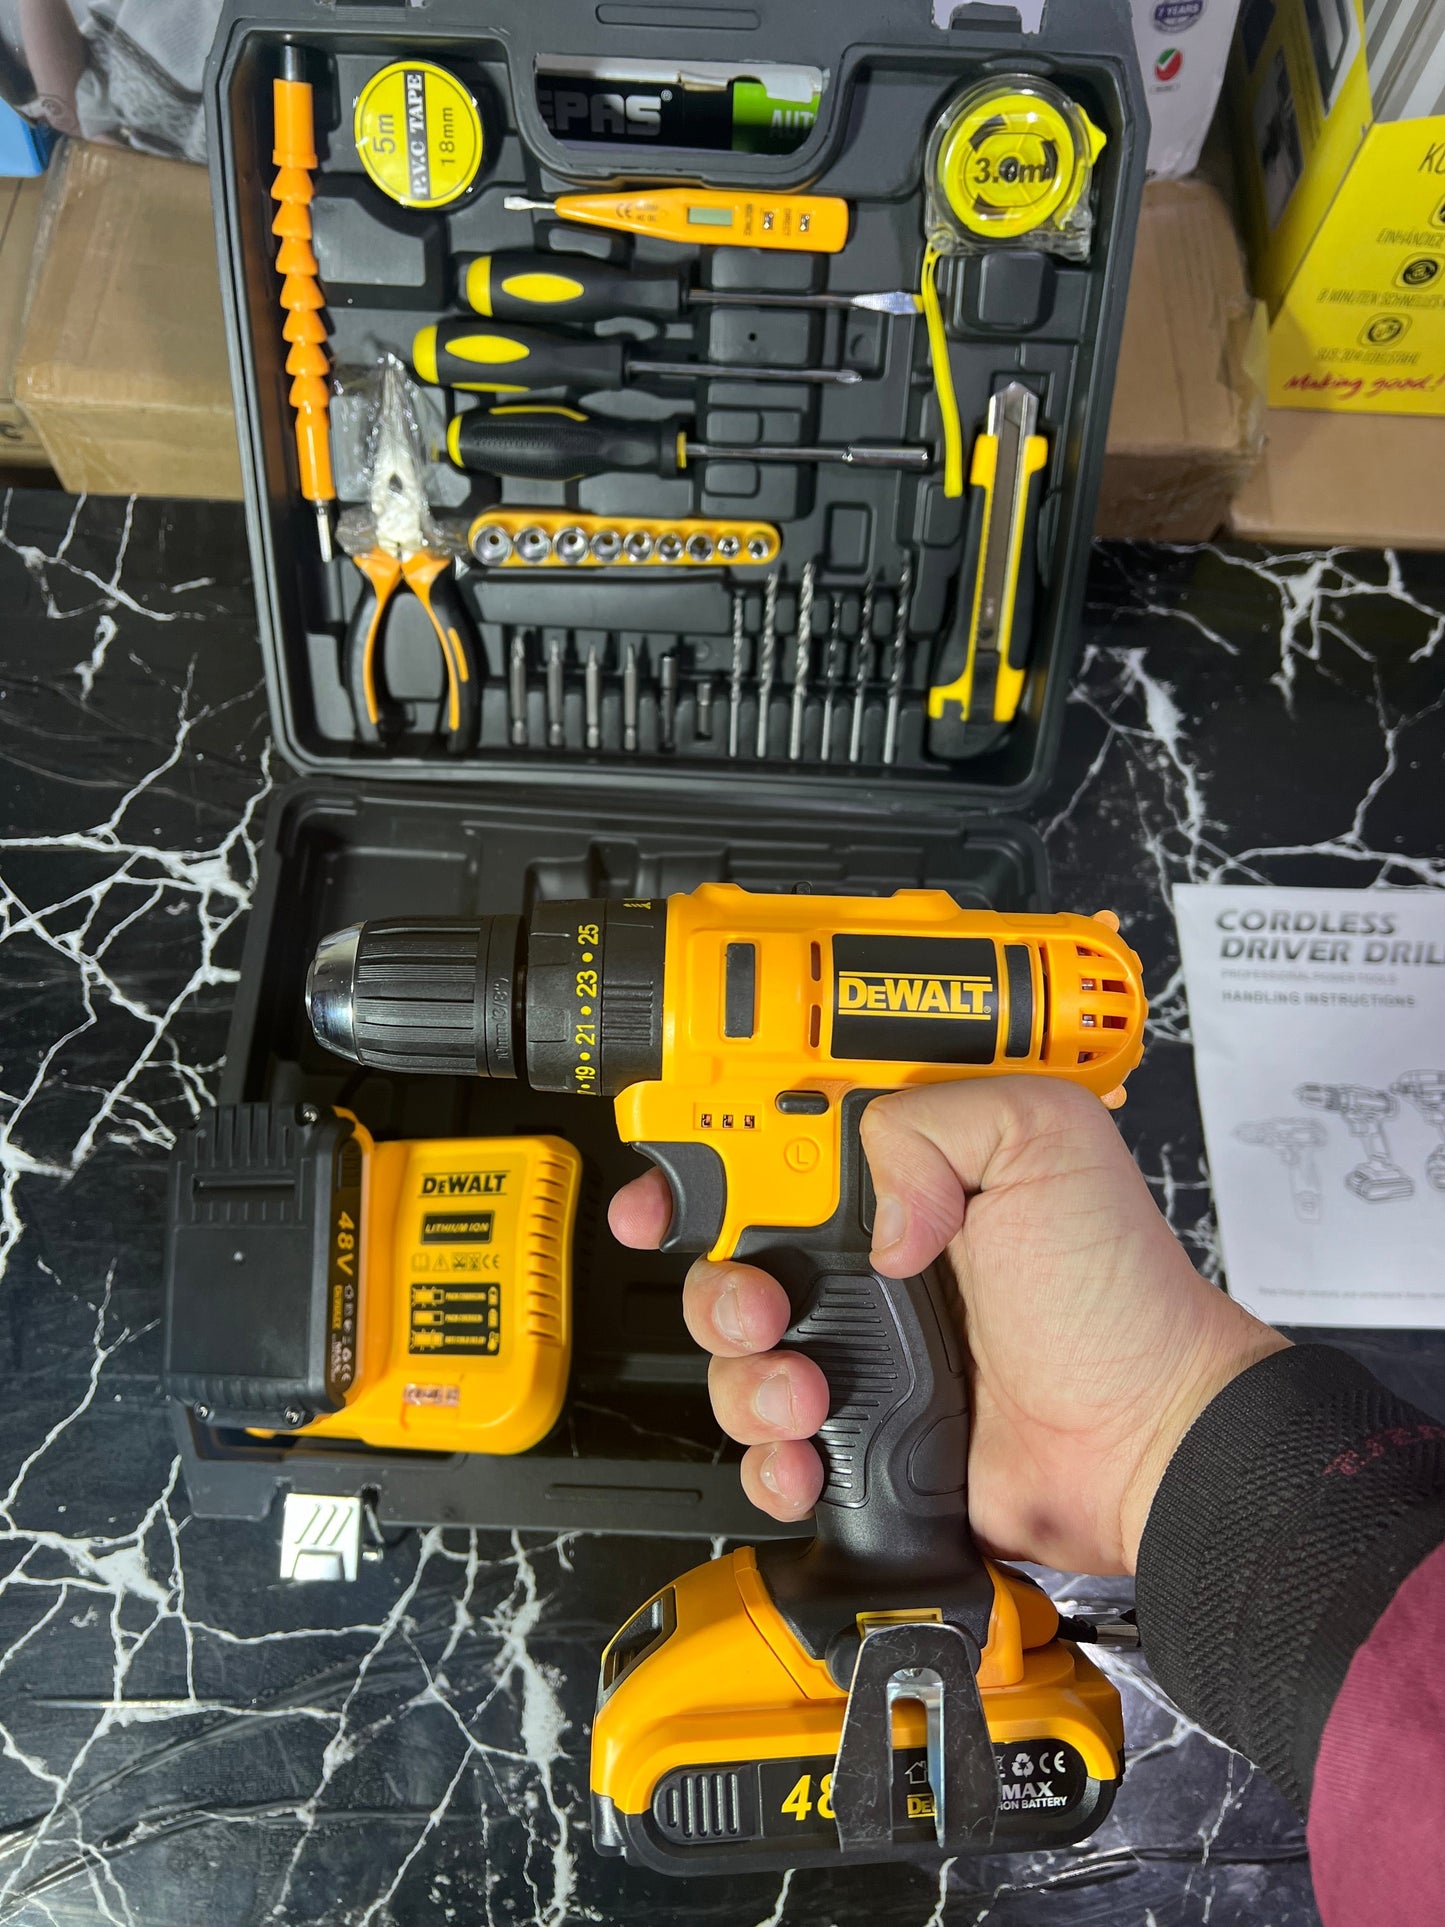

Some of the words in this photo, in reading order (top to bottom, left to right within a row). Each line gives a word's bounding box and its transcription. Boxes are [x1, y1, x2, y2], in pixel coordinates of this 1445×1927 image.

[406, 73, 425, 134] TAPE
[372, 113, 396, 156] 5m
[439, 107, 455, 167] 18mm
[1285, 372, 1363, 401] Making
[1216, 909, 1397, 934] CORDLESS
[577, 923, 599, 946] 25
[1220, 936, 1349, 962] DRIVER
[576, 970, 598, 998] 23
[1222, 989, 1300, 1006] HANDLING
[1304, 991, 1415, 1008] INSTRUCTIONS
[575, 1024, 596, 1046] 21
[575, 1066, 597, 1081] 19
[425, 1223, 468, 1234] LITHIUM
[469, 1222, 490, 1233] ION
[336, 1211, 355, 1276] 48V
[1002, 1781, 1054, 1801] MAX
[1022, 1796, 1068, 1809] BATTERY
